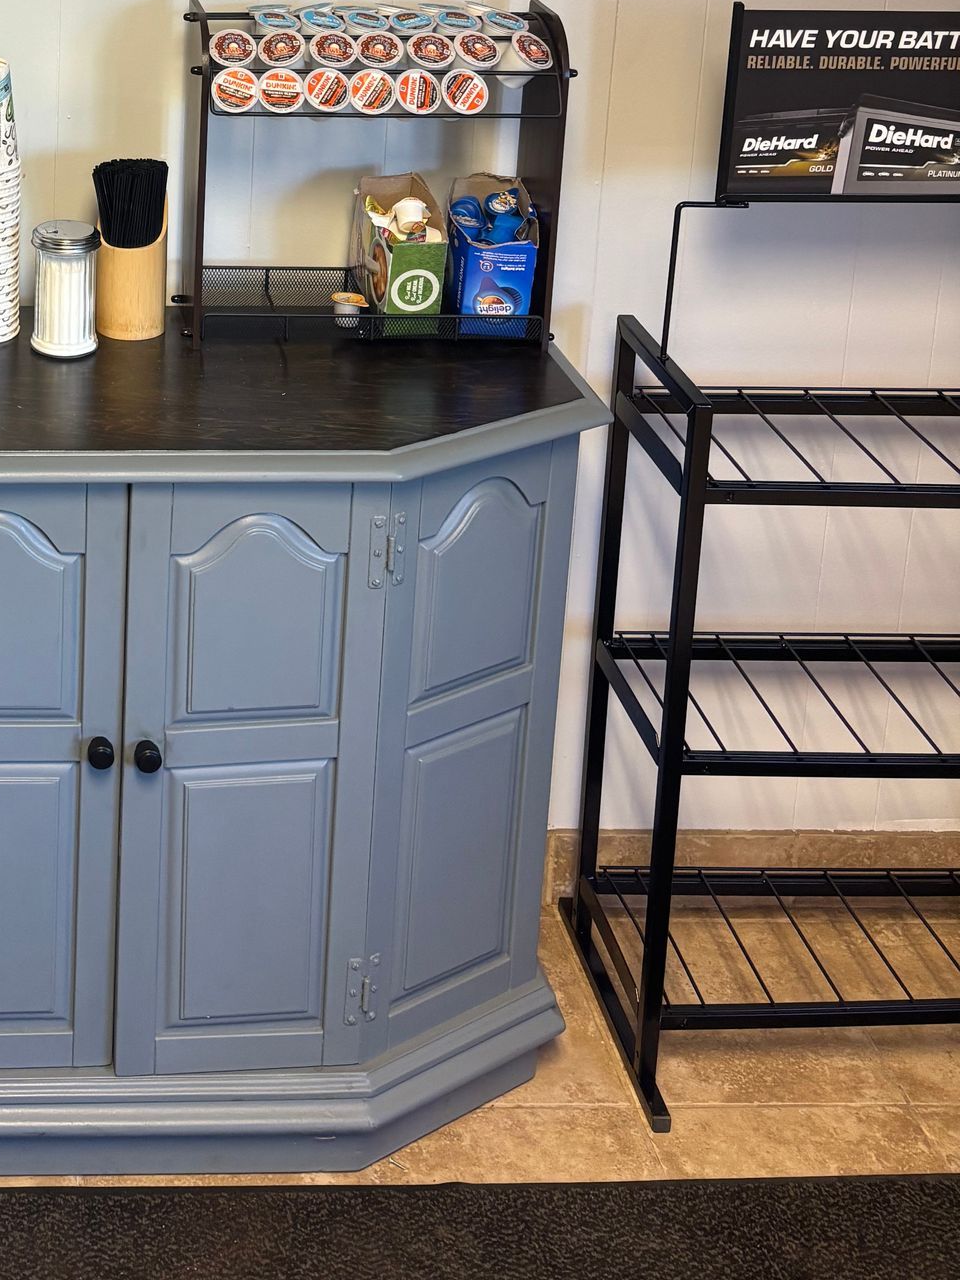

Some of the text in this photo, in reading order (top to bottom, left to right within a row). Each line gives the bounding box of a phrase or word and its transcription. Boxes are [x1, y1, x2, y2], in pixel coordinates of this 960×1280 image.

[748, 29, 819, 49] HAVE
[825, 30, 895, 49] YOUR
[746, 55, 814, 70] RELIABLE.
[818, 56, 885, 70] DURABLE.
[742, 133, 819, 151] DieHard
[868, 123, 954, 150] DieHard
[809, 165, 834, 173] GOLD
[478, 304, 512, 314] delight
